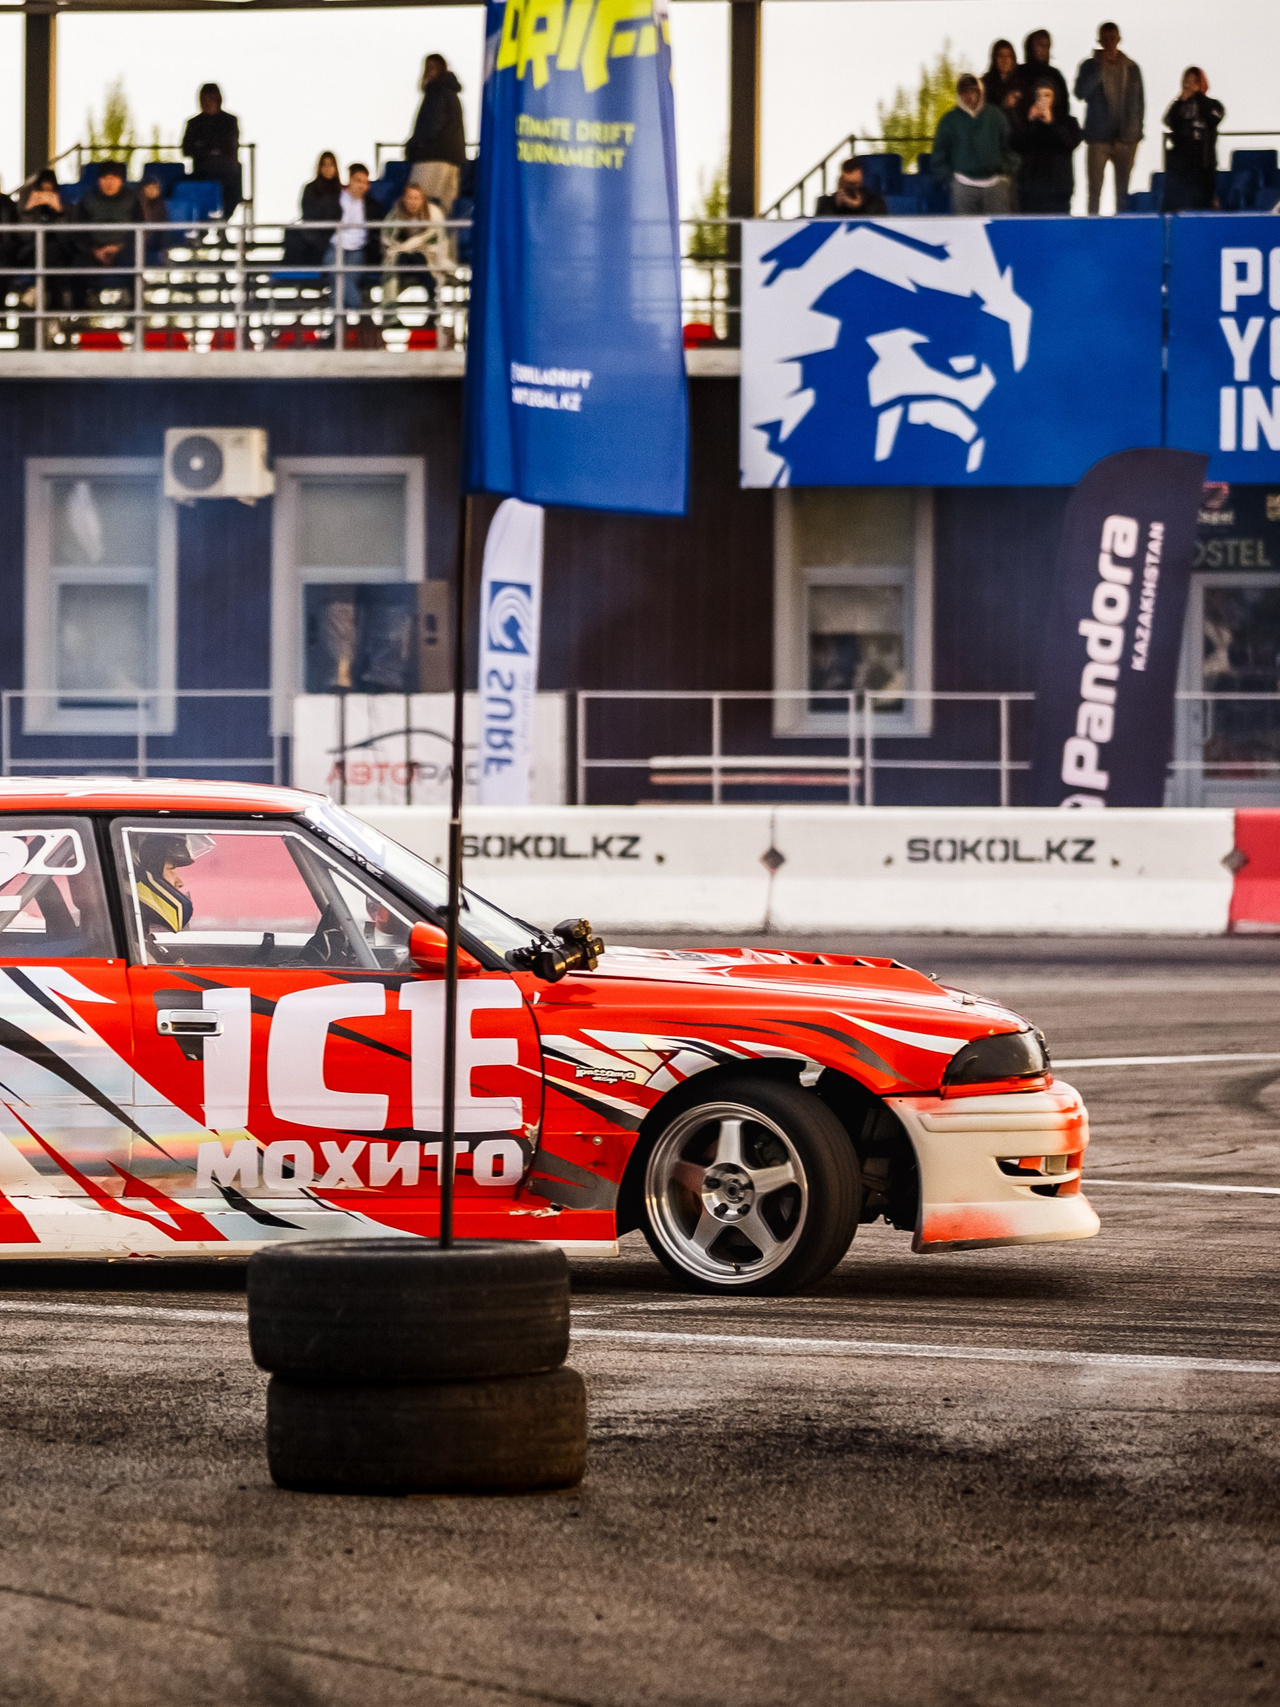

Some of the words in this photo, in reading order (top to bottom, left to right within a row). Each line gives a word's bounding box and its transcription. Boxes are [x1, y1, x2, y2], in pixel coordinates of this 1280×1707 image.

[497, 0, 658, 92] DRIF
[1221, 247, 1280, 312] P
[1219, 316, 1280, 382] Y
[1061, 514, 1139, 790] Pandora
[462, 834, 640, 859] SOKOL.KZ
[906, 837, 1096, 863] SOKOL.KZ
[202, 979, 523, 1132] ICE
[196, 1139, 523, 1190] МОХИТО
